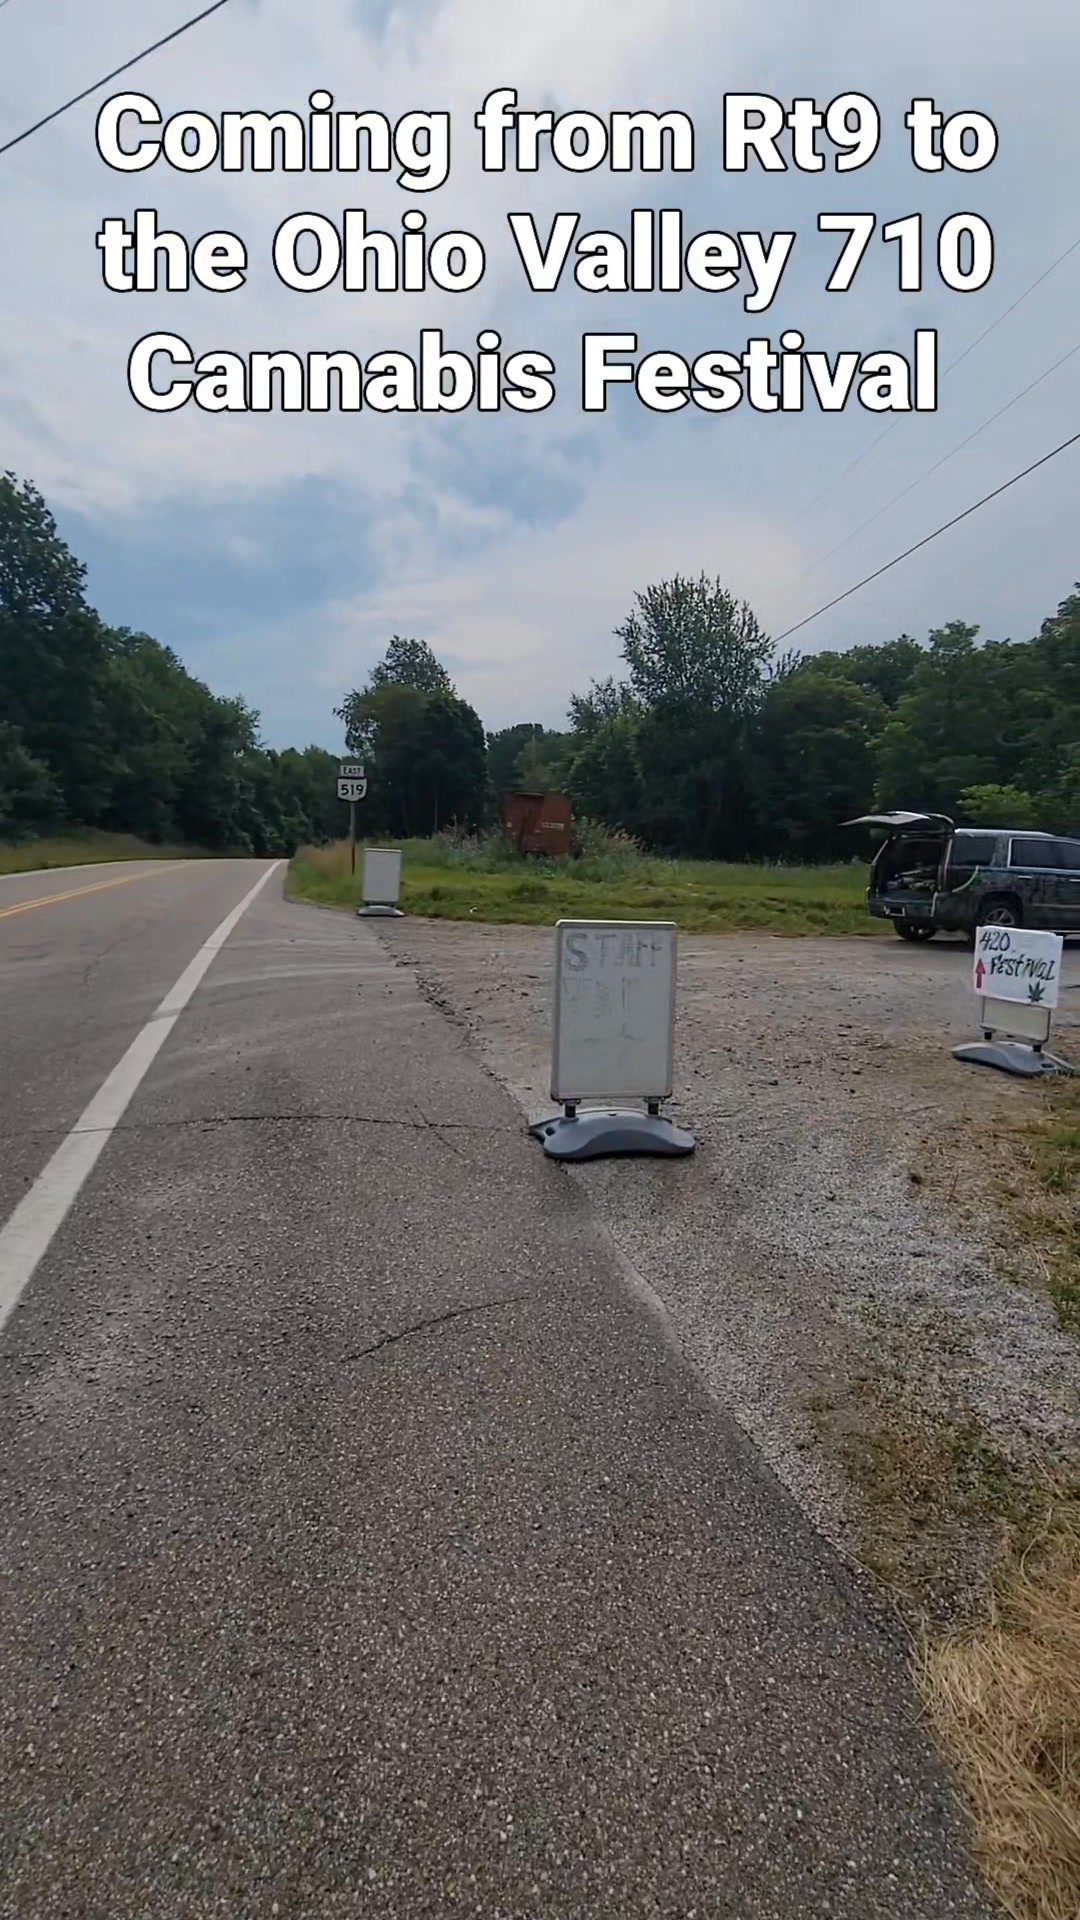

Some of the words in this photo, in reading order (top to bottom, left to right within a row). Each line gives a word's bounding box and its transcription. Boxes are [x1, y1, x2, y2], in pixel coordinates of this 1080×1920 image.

[343, 766, 361, 775] EAST
[341, 784, 364, 796] 519
[979, 931, 1011, 952] 420
